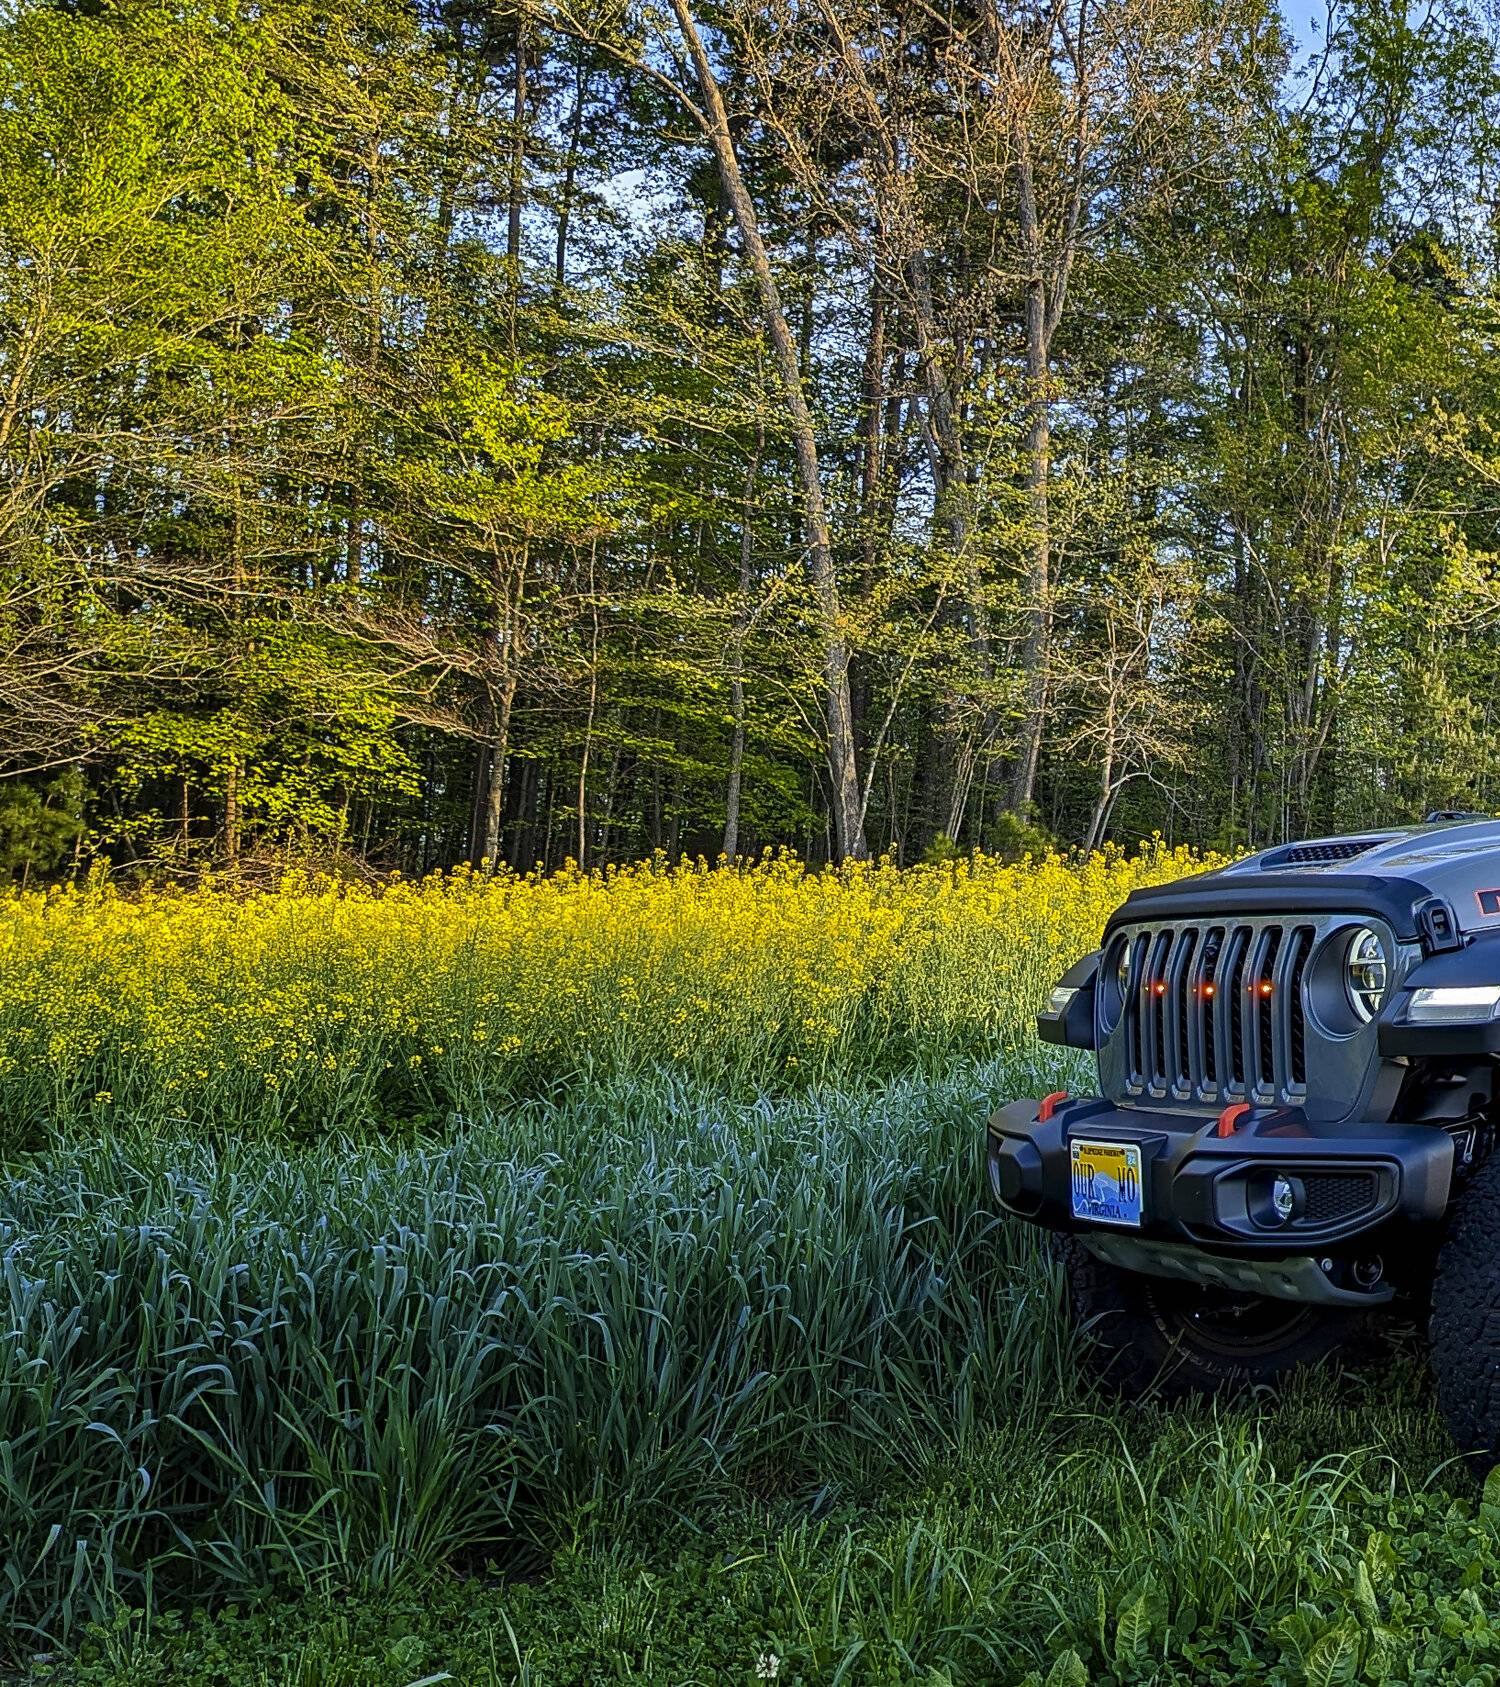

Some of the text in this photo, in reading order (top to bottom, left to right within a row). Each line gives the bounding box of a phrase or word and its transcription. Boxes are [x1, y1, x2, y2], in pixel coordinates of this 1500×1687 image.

[1073, 1161, 1136, 1202] OUR MO
[1088, 1202, 1121, 1218] VIRGINIA
